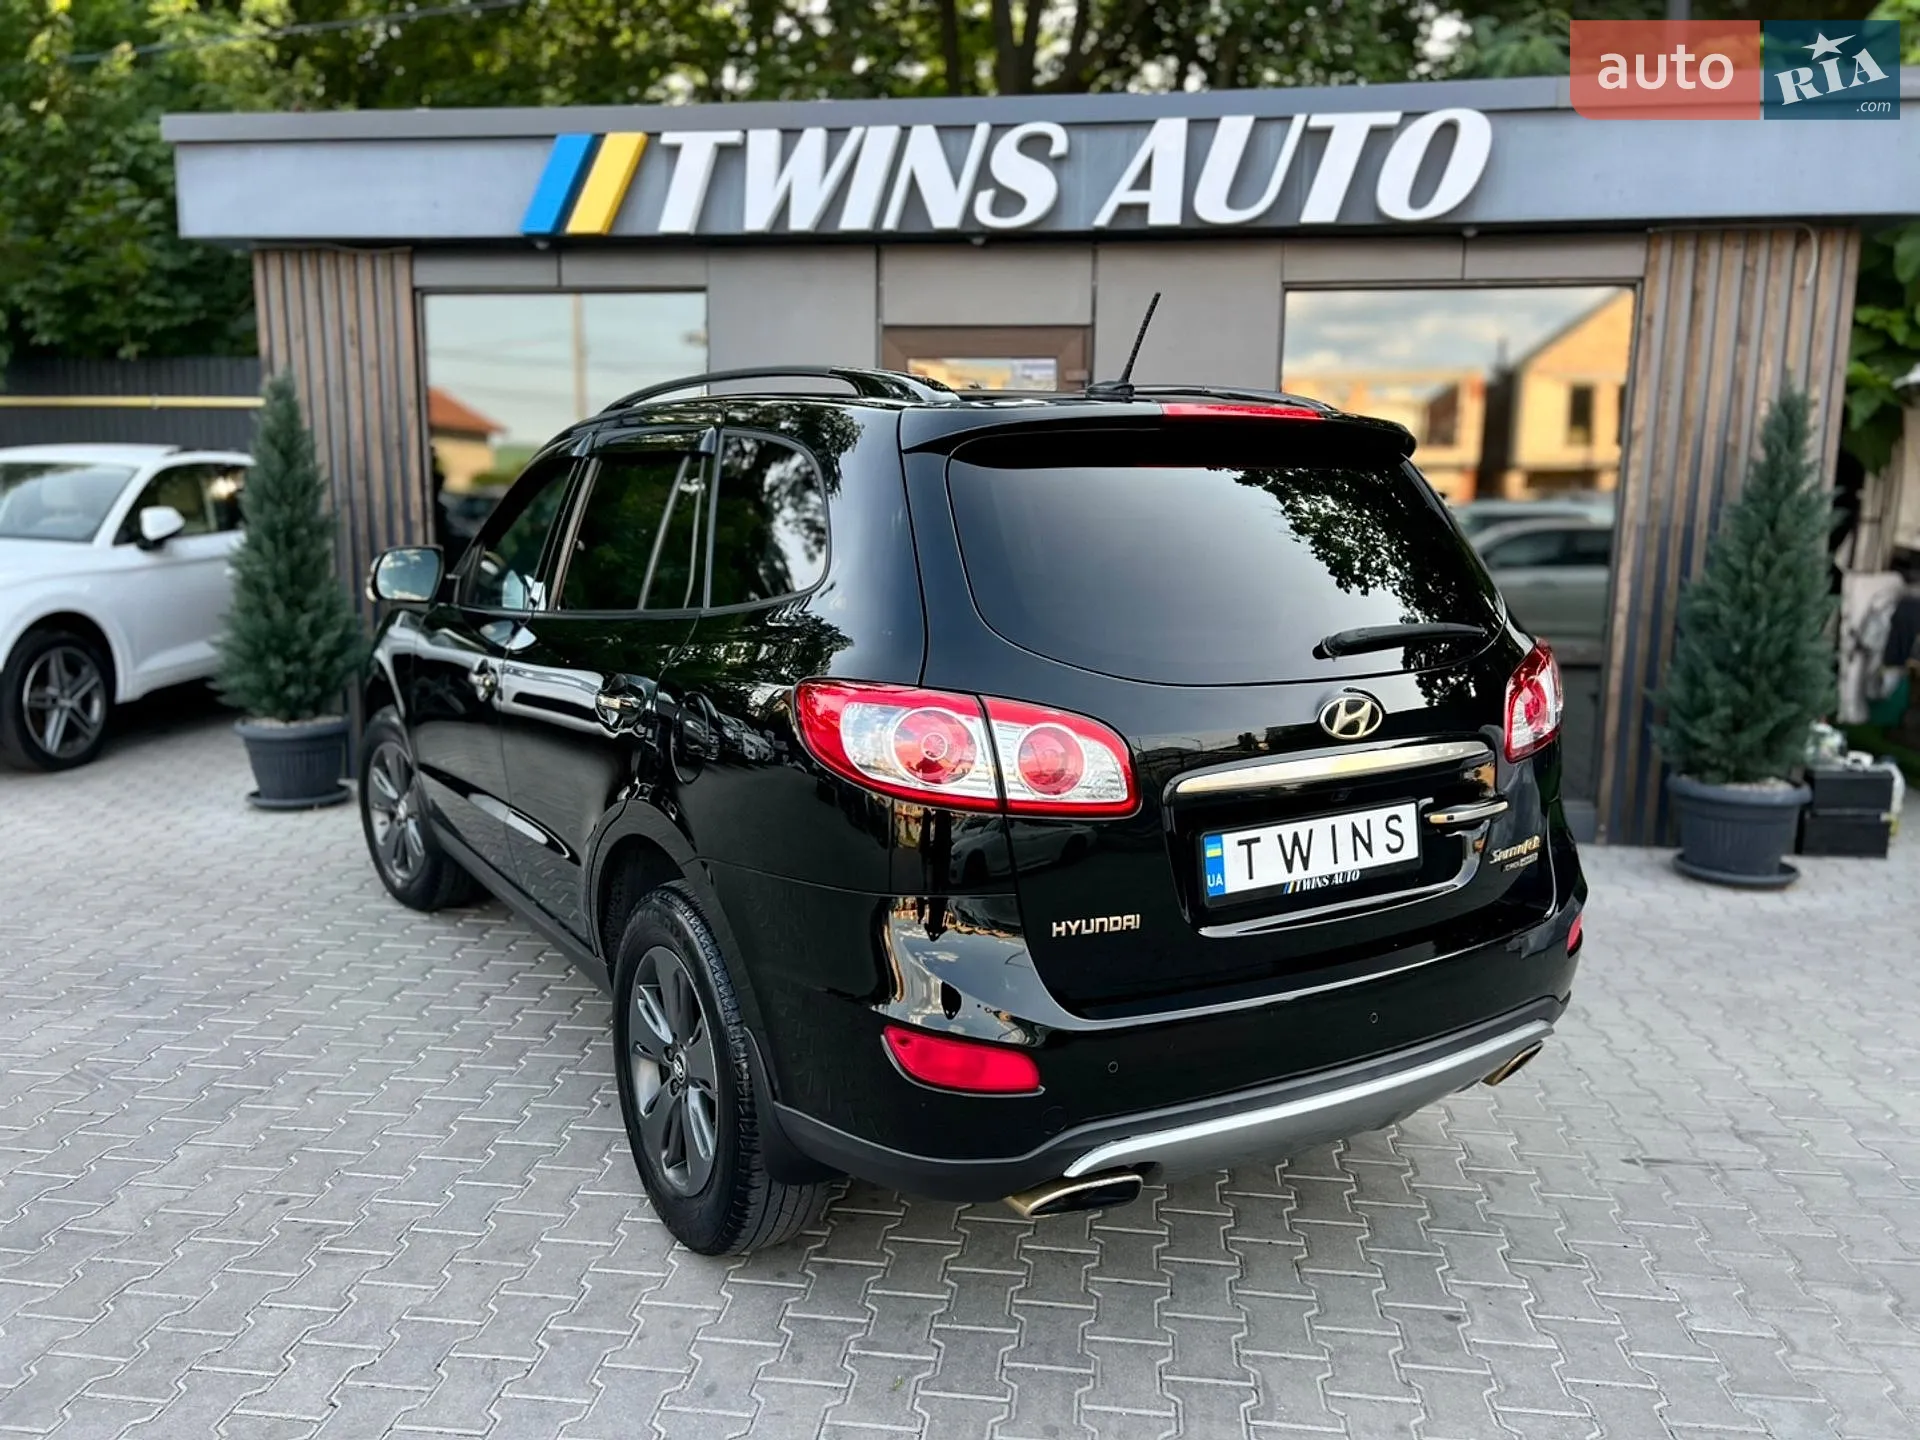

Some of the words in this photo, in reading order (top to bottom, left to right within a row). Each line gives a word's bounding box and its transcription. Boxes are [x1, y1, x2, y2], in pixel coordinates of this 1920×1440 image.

[658, 121, 1068, 233] TWINS
[1093, 107, 1493, 228] AUTO
[1207, 873, 1224, 888] UA
[1295, 874, 1329, 892] TWINS
[1331, 869, 1361, 886] AUTO
[1052, 913, 1141, 938] HYUNDAI
